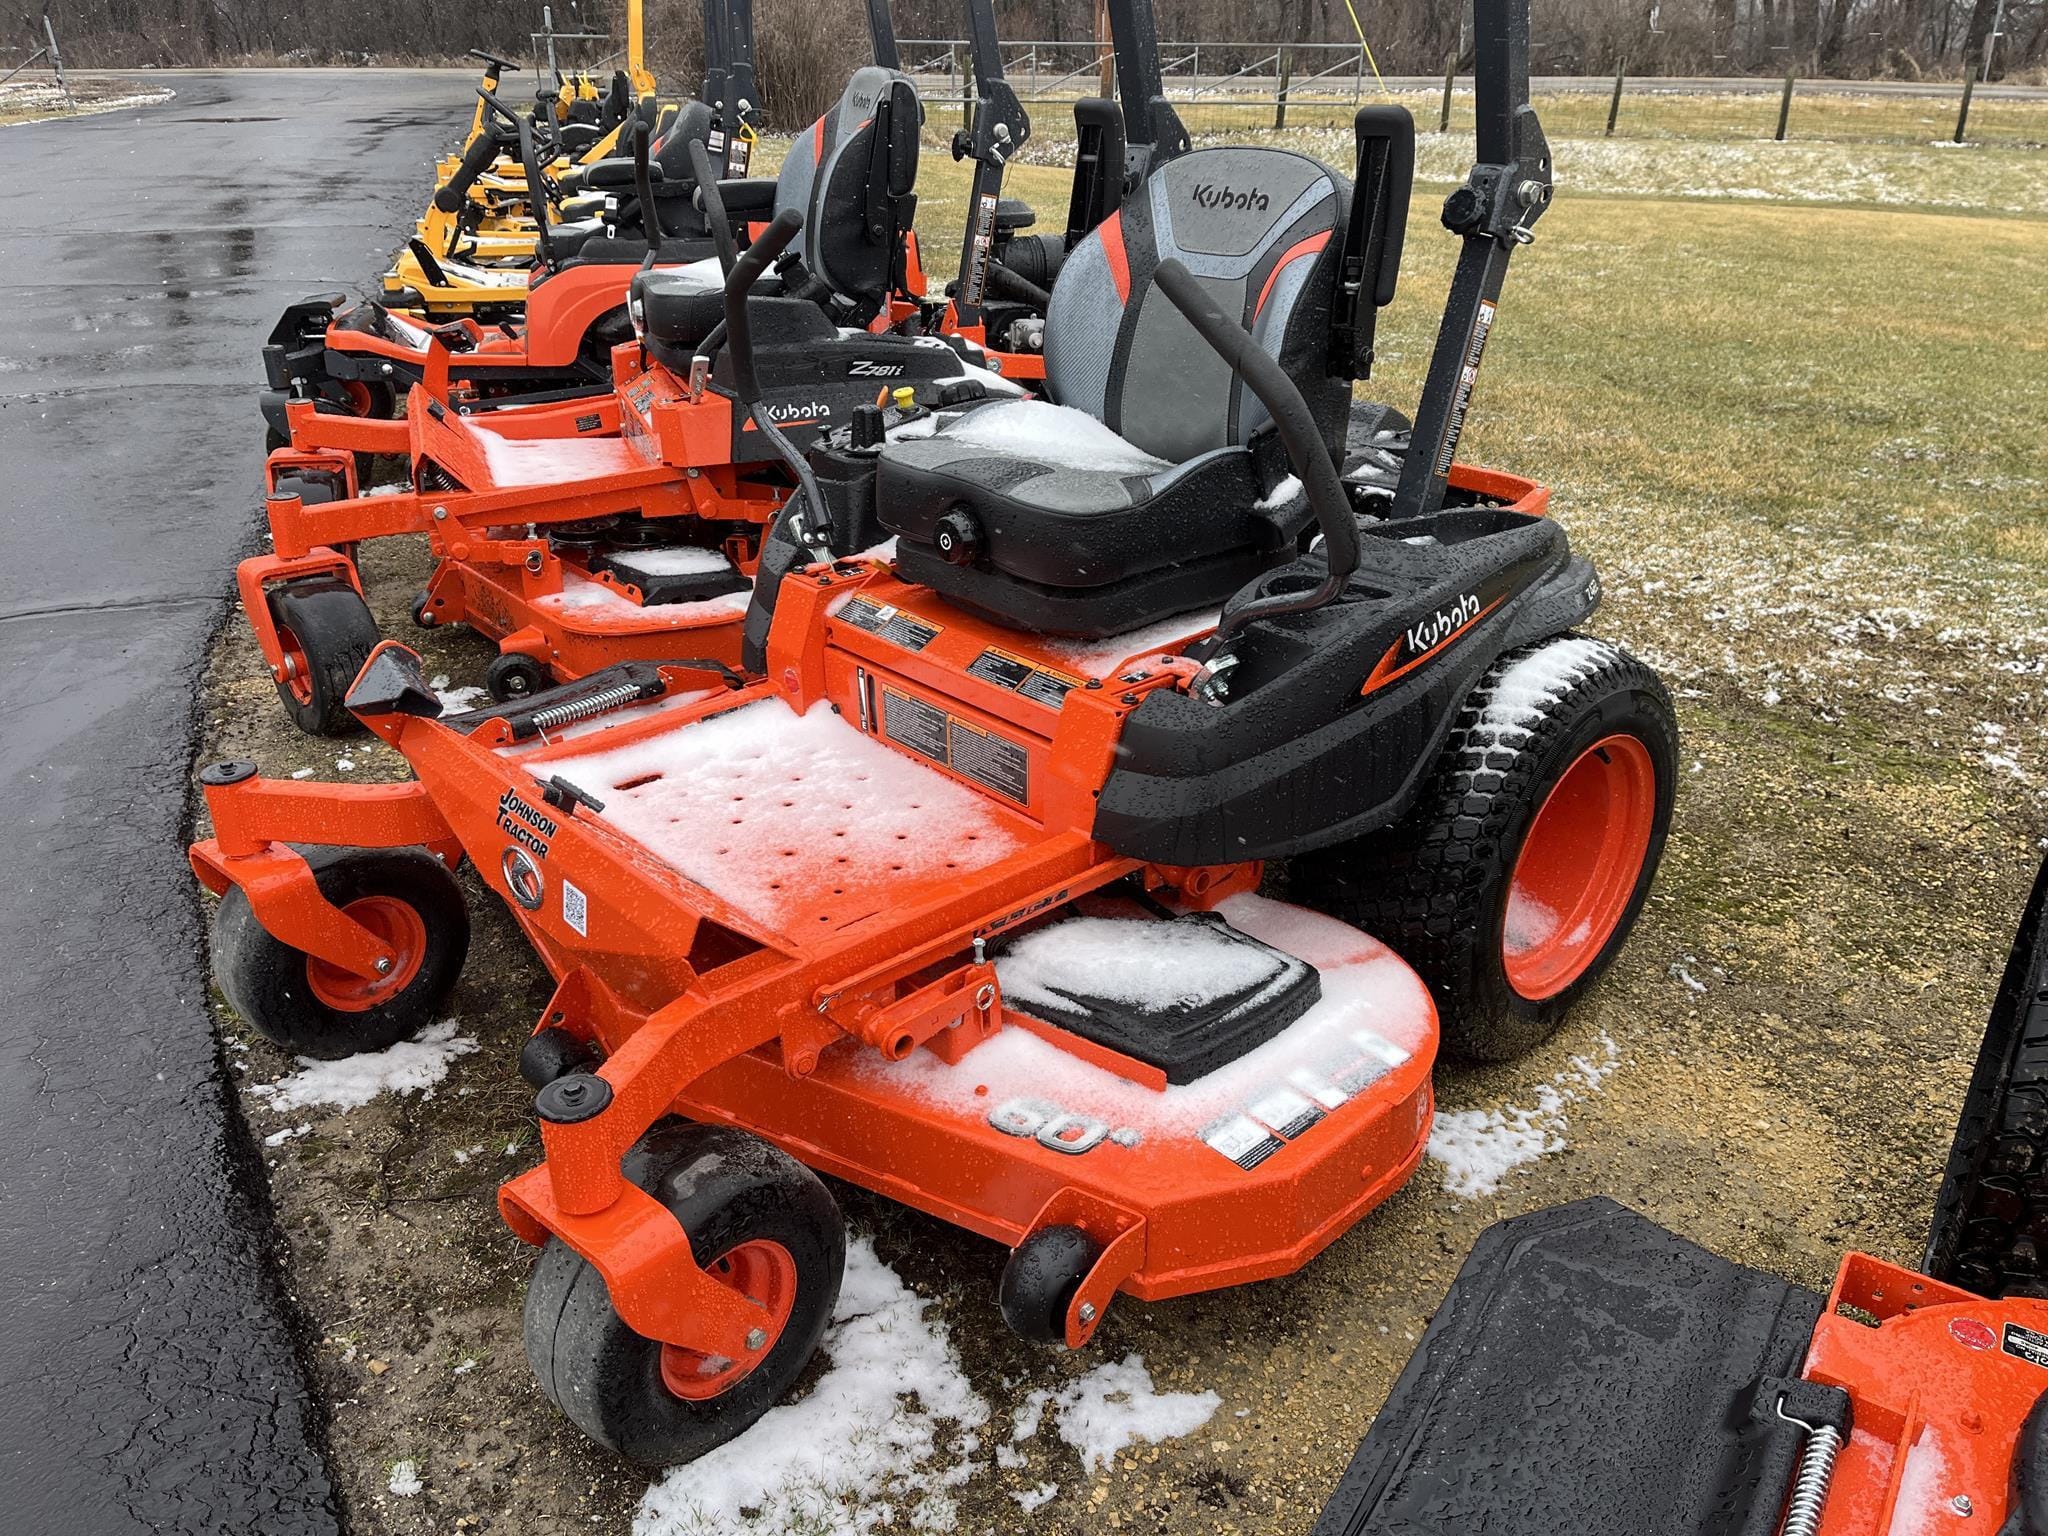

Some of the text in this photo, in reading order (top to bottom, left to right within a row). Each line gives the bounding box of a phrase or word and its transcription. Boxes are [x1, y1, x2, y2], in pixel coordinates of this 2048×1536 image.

[1192, 184, 1270, 211] Kubota
[848, 360, 904, 376] Z781i
[1407, 594, 1480, 653] Kubota
[496, 806, 548, 859] TRACTOR
[502, 788, 557, 837] JOHNSON
